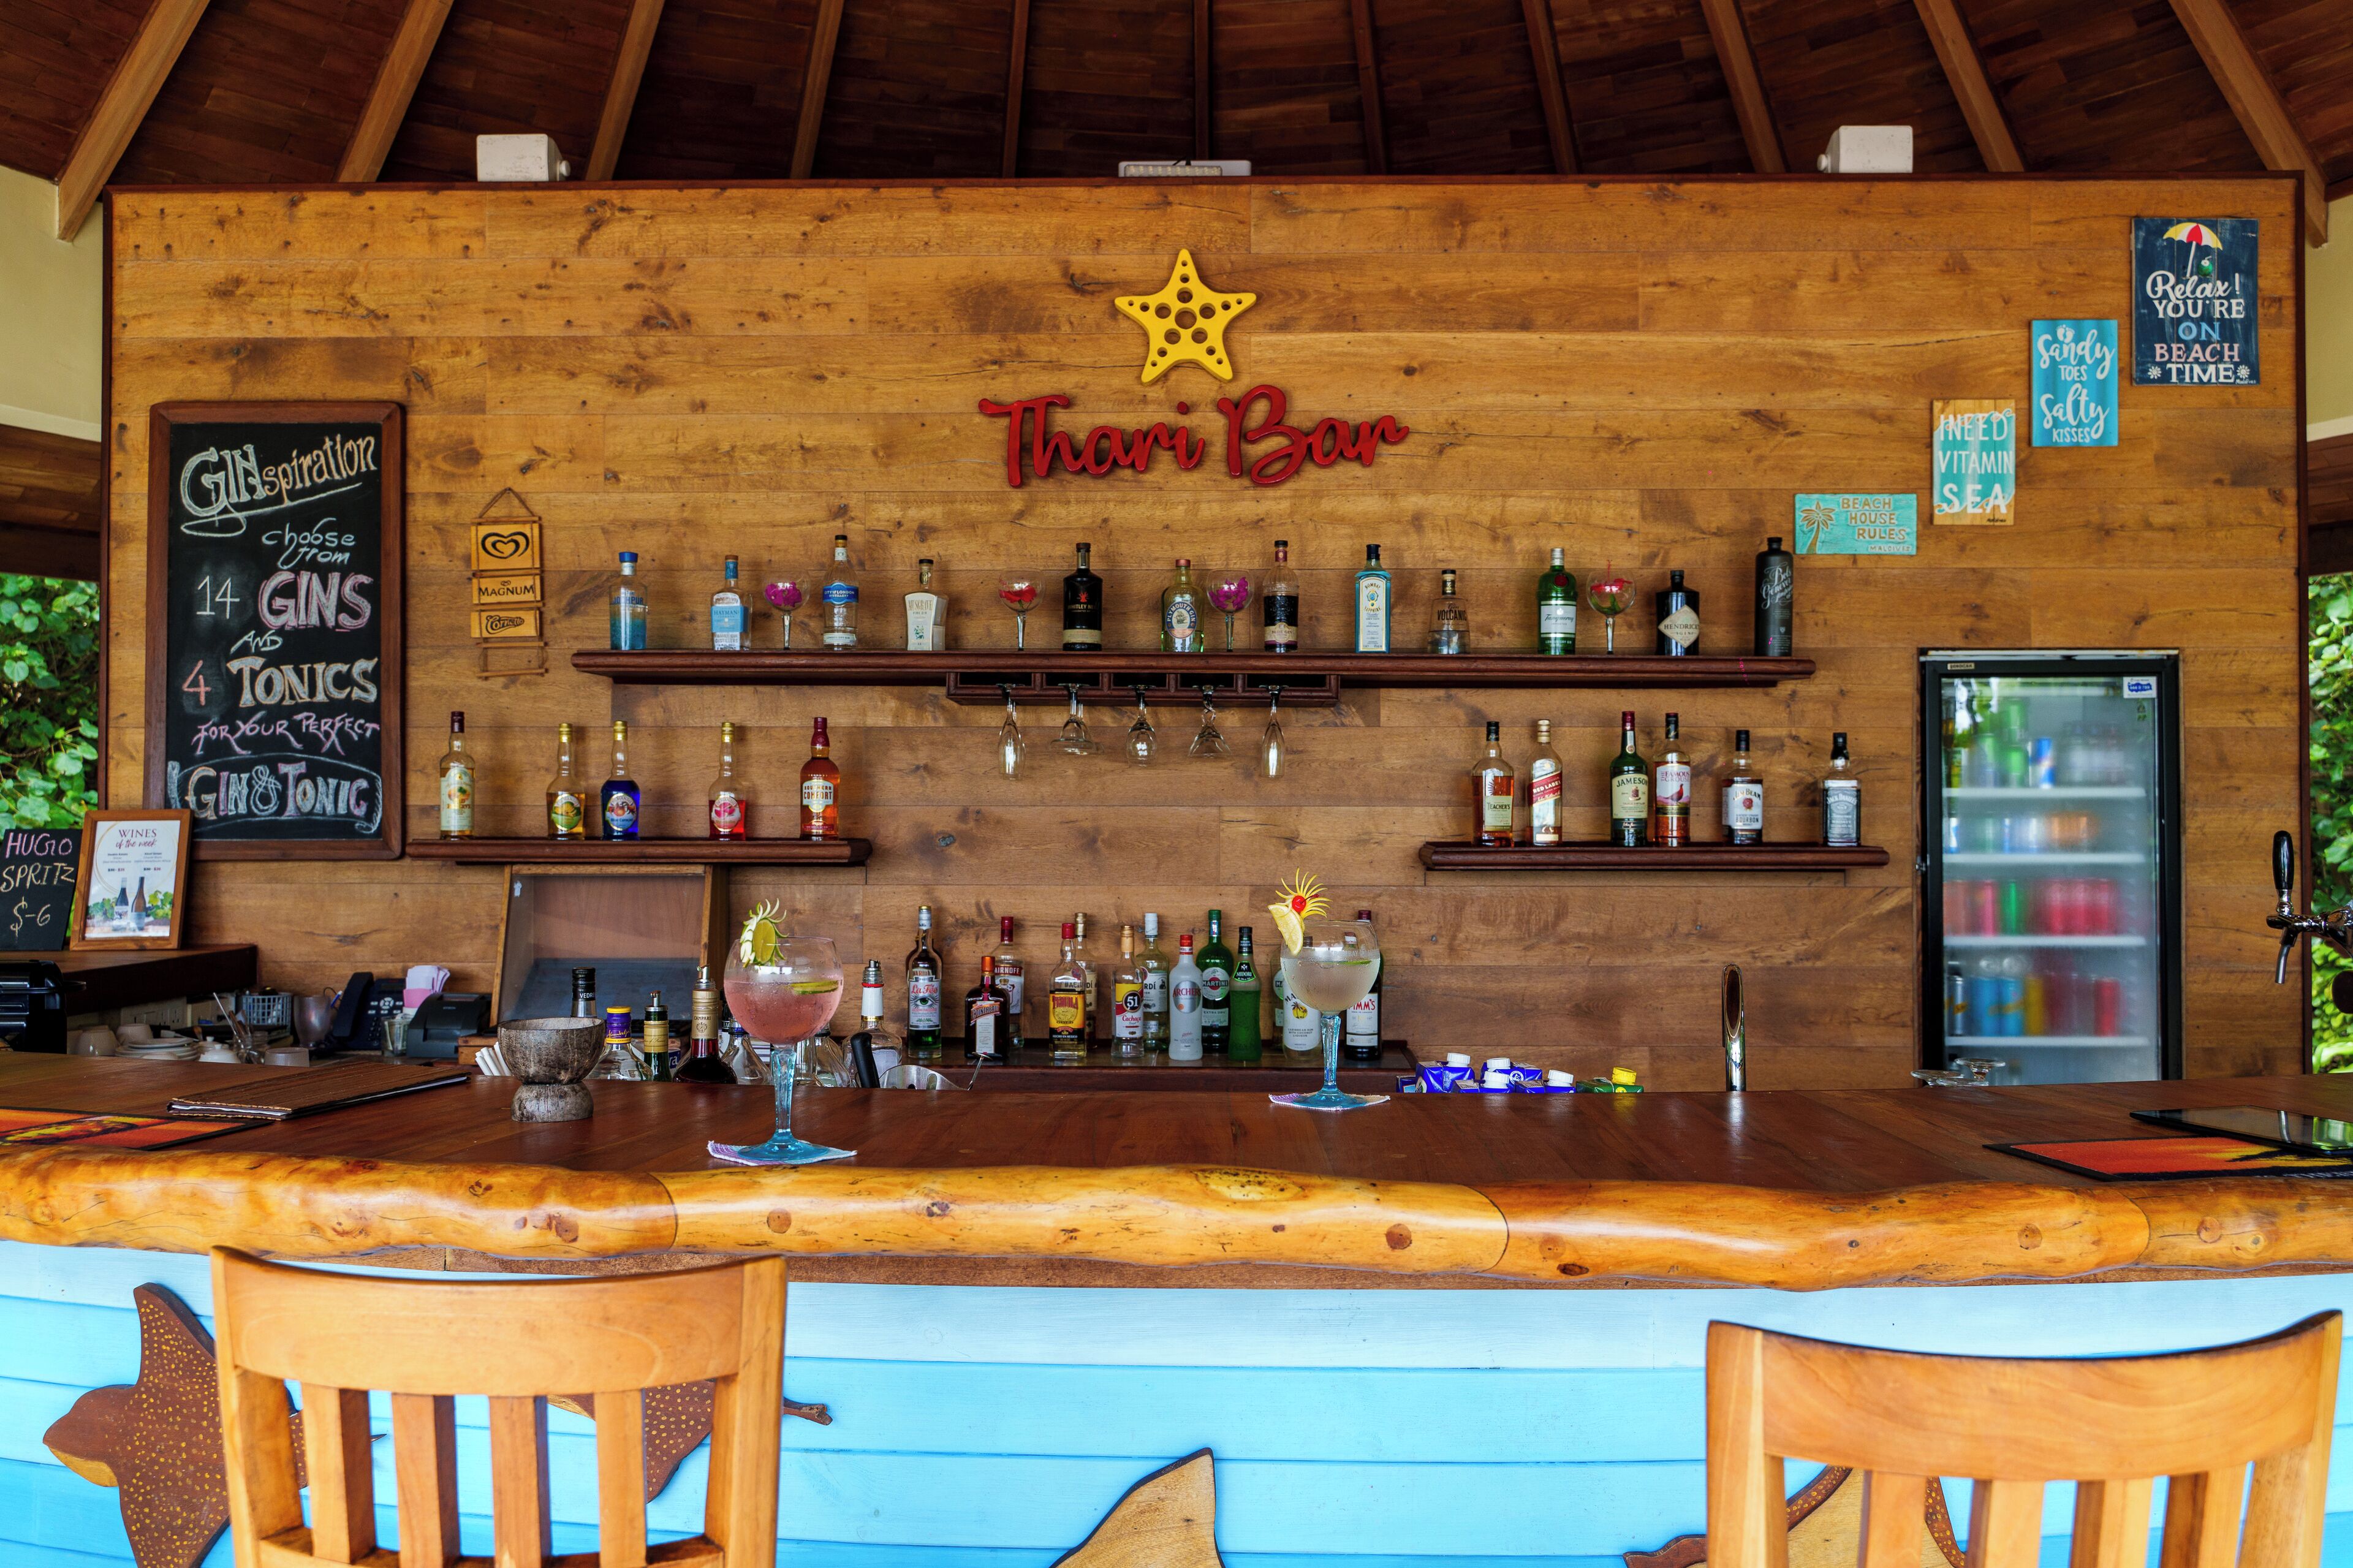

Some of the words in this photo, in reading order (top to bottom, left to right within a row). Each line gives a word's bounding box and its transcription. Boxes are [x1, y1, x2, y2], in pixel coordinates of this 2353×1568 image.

[2153, 299, 2245, 319] YOU'RE
[2178, 322, 2221, 341] ON
[2037, 329, 2115, 380] Sandy
[2154, 343, 2240, 362] BEACH
[2058, 365, 2088, 382] TOES
[2166, 363, 2235, 384] TIME
[2039, 384, 2110, 440] Salty
[978, 394, 1205, 488] Thari
[1217, 384, 1410, 486] Bar
[1947, 413, 2008, 441] NEED
[2052, 427, 2091, 443] KISSES
[1938, 450, 2014, 474] VITAMIN
[180, 434, 378, 518] GINspiration
[1841, 497, 1893, 510] BEACH
[1941, 483, 2007, 514] SEA
[1849, 512, 1897, 525] HOUSE
[261, 518, 356, 556] choose
[1856, 528, 1907, 541] RULES
[479, 583, 535, 597] MAGNUM
[196, 575, 240, 619] 14
[258, 570, 374, 631] GINS
[613, 596, 643, 605] JOHPUR
[907, 600, 933, 611] MUSGRAVE
[1167, 602, 1191, 622] PLYMOUTH
[1437, 609, 1467, 621] VOLCANIC
[1544, 614, 1575, 623] Tanqueray
[485, 615, 525, 635] Cornetto
[230, 629, 283, 654] AND
[182, 659, 211, 706] 4
[226, 655, 379, 708] TONICS
[191, 718, 251, 756] FOR
[233, 710, 304, 749] YOUR
[293, 711, 381, 756] PERFECT
[185, 766, 250, 820] GIN
[278, 761, 369, 817] TONIC
[803, 791, 832, 800] COMFORT
[1487, 802, 1510, 811] TEACHER'S
[119, 828, 157, 838] WINES
[5, 831, 73, 859] HUGO
[115, 839, 124, 850] of
[125, 839, 136, 848] the
[138, 838, 157, 847] week
[0, 862, 75, 893] SPRITZ
[911, 983, 922, 994] La
[972, 1004, 999, 1020] COINTREAU
[1126, 996, 1139, 1010] 51
[1348, 998, 1376, 1011] IMM'S
